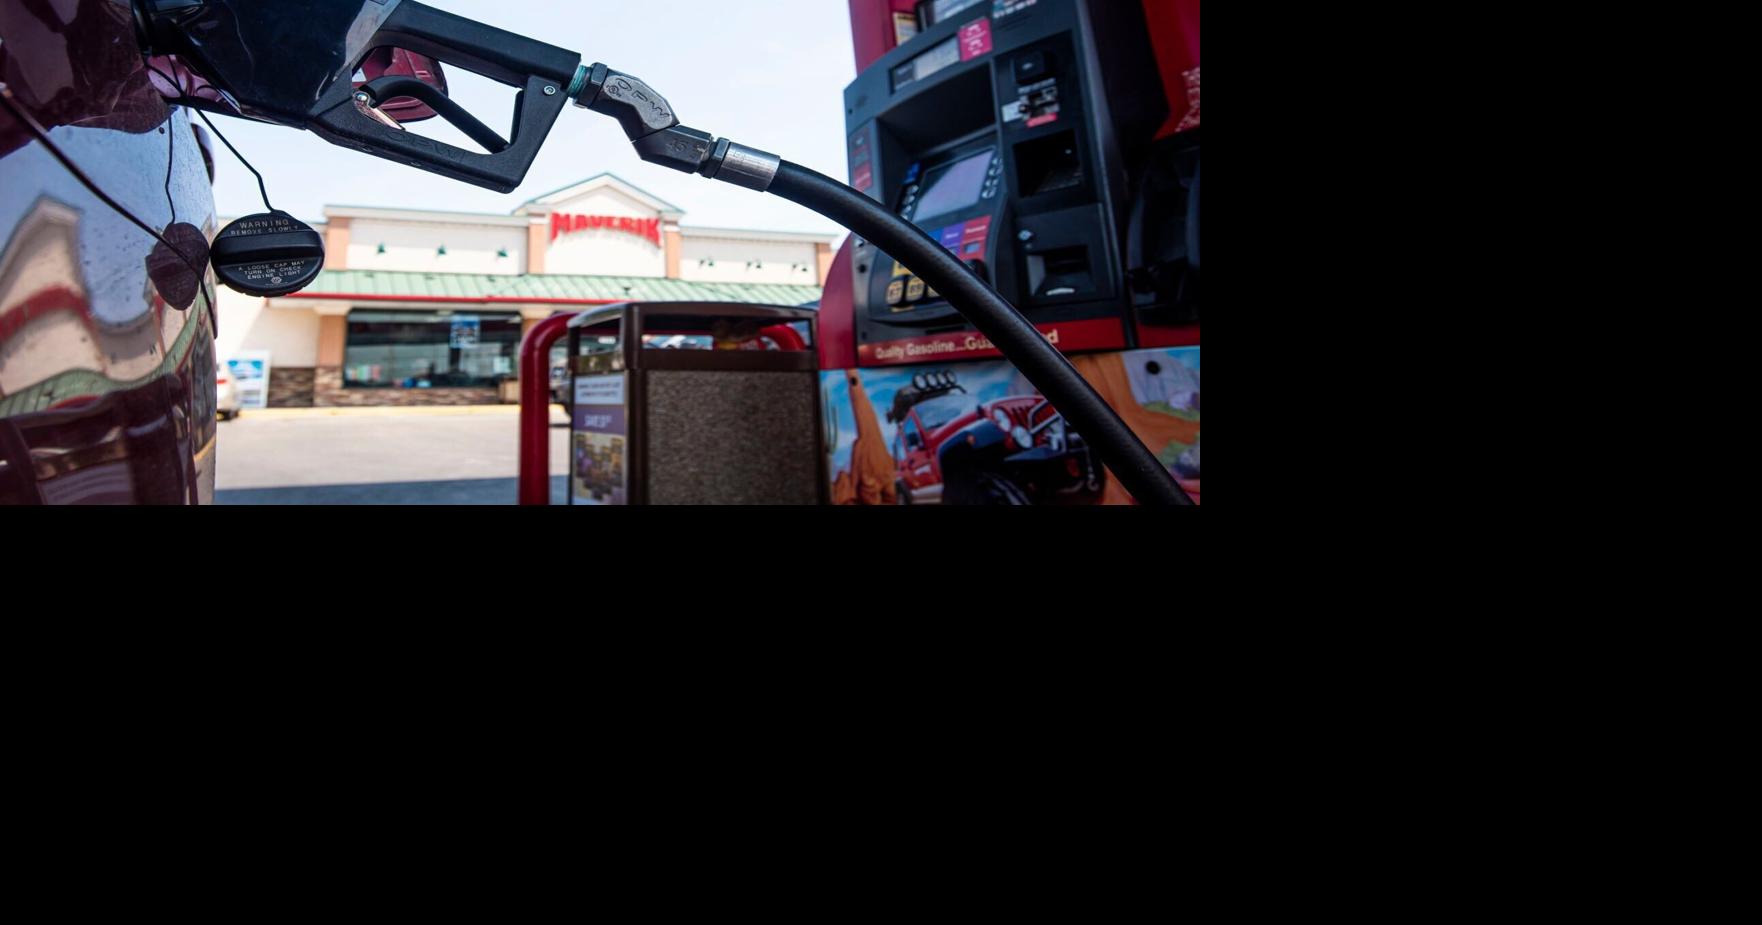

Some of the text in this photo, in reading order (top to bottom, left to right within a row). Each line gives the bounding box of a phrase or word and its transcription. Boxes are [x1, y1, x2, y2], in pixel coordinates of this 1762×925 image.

[614, 77, 671, 118] OPW
[240, 219, 289, 229] WARNING
[268, 225, 298, 233] SLOWLY
[550, 212, 661, 249] MAVERIK
[876, 346, 904, 360] Quality
